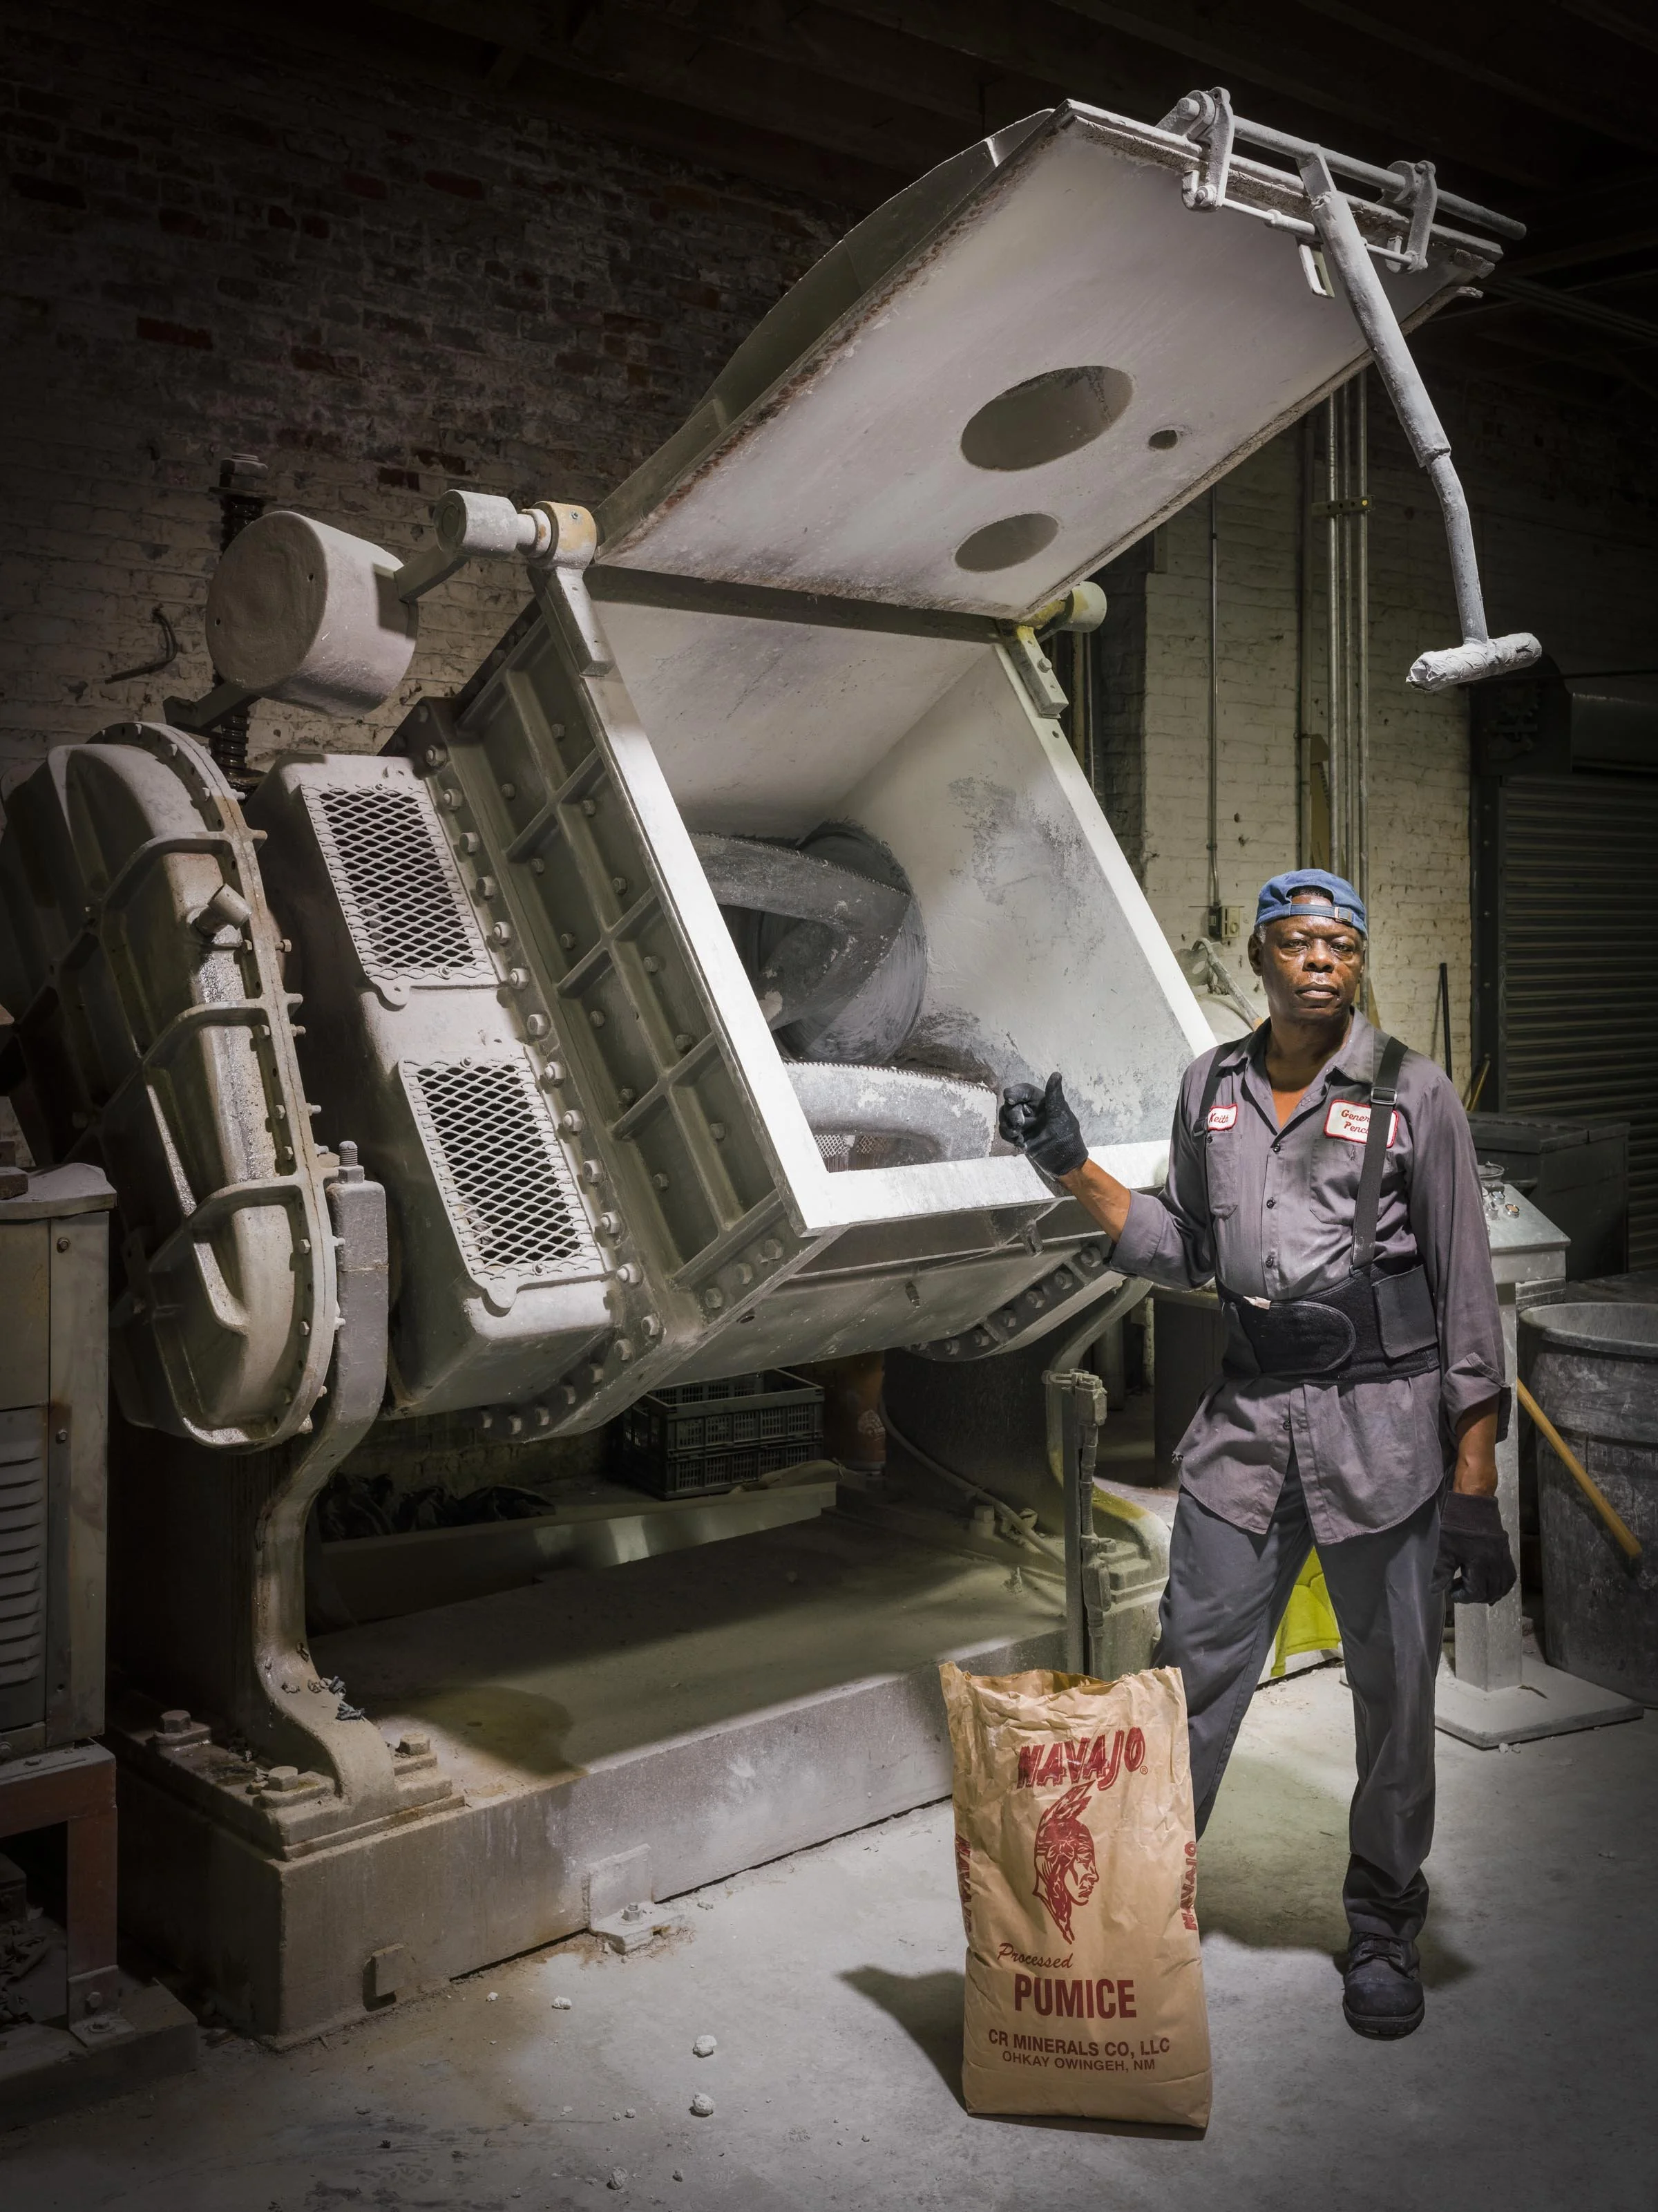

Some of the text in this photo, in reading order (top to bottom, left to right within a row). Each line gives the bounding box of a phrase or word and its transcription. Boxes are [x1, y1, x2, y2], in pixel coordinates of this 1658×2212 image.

[1209, 1113, 1228, 1124] Keith
[1016, 1726, 1145, 1791] NAVAJO
[997, 1942, 1074, 1969] Processed
[1014, 1973, 1137, 2019] PUMICE
[989, 2028, 1170, 2059] CR MINERALS CO, LLC
[1002, 2050, 1155, 2073] OHKAY OWINGEH, NM
